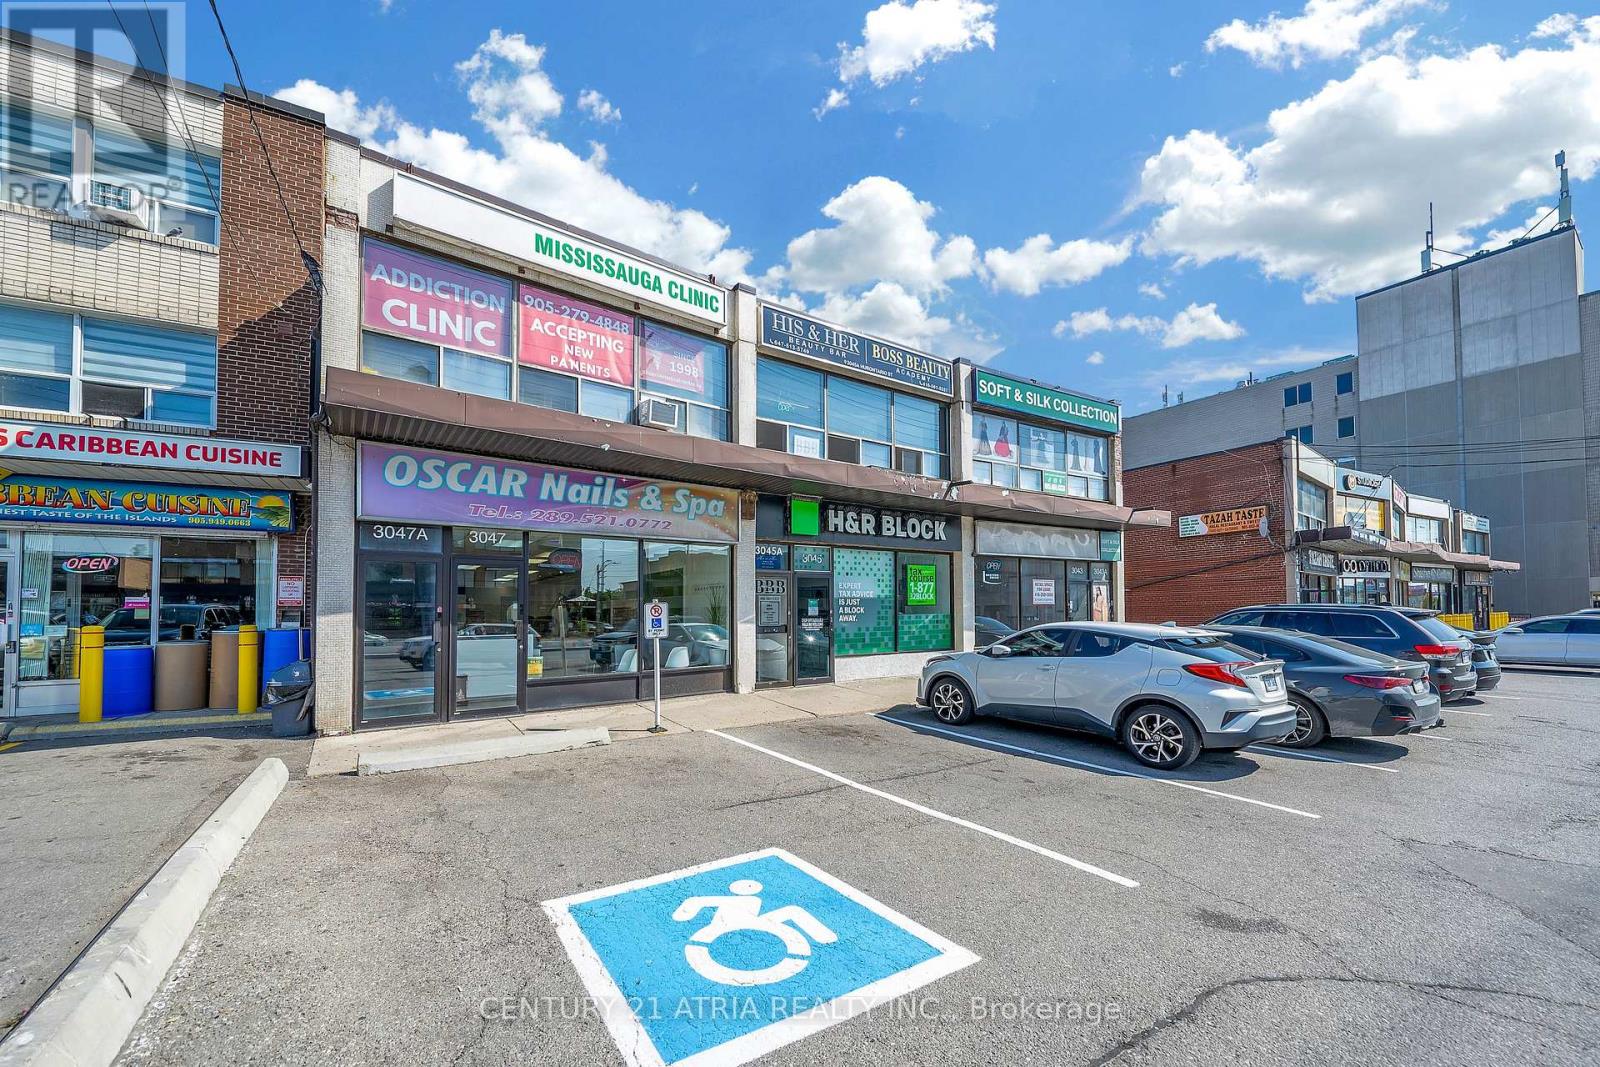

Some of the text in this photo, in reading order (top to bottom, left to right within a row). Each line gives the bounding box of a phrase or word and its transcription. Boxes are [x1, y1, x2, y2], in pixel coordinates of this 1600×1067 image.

[535, 233, 720, 313] MISSISSAUGA CLINIC
[370, 263, 506, 314] ADDICTION
[382, 298, 497, 347] CLINIC
[524, 294, 630, 336] 905-279-4848
[530, 318, 624, 353] ACCEPTING
[772, 313, 860, 353] HIS & HER
[564, 344, 594, 360] NEW
[788, 336, 847, 358] BEAUTY BAR
[671, 361, 700, 378] 1998
[872, 343, 950, 379] BOSS BEAUTY
[895, 367, 931, 382] ACADEMY
[979, 379, 1117, 425] SOFT & SILK COLLECTION
[15, 430, 178, 459] CARIBBEAN
[185, 444, 283, 468] CUISINE
[384, 453, 726, 520] OSCAR Nails & Spa
[121, 490, 251, 519] CUISINE
[29, 508, 72, 518] TASTE
[95, 512, 122, 520] THE
[125, 514, 178, 524] ISLANDS
[528, 508, 673, 531] 289.521.0772
[827, 508, 947, 541] H&R BLOCK
[1204, 508, 1265, 524] TAZAH TASTE
[372, 524, 429, 541] 3047A
[468, 530, 506, 545] 3047
[755, 545, 783, 556] 3045A
[802, 553, 823, 564] 3045
[65, 557, 112, 570] OPEN
[839, 590, 874, 598] TAX ADVICE
[909, 582, 934, 593] 1-877
[838, 614, 858, 622] AWAY.
